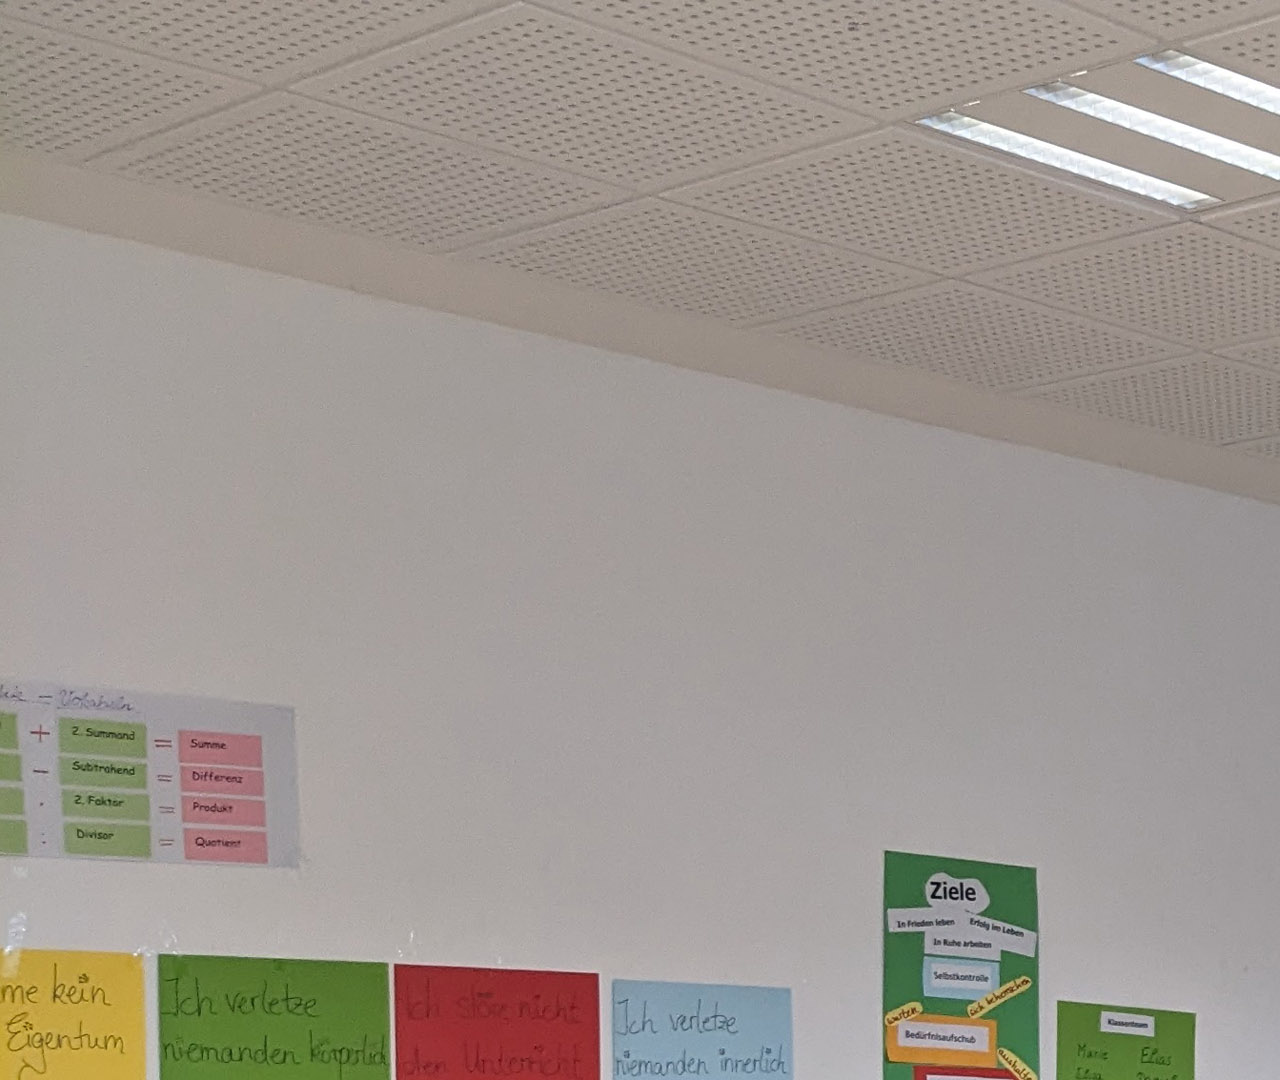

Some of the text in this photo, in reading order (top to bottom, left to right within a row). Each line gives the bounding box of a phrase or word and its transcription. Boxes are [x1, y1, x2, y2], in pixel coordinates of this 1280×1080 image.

[86, 728, 136, 740] Summand
[190, 739, 227, 751] Summe
[72, 761, 136, 775] Subtrahend
[192, 772, 243, 784] Differenz
[88, 797, 125, 808] Faktor
[193, 802, 234, 814] Produkt
[77, 829, 114, 841] Divisor
[195, 837, 242, 849] Quotient
[930, 881, 977, 902] Ziele
[907, 919, 934, 928] Frieden
[969, 917, 990, 931] Erfolg
[1002, 926, 1025, 938] Leben
[943, 938, 962, 948] Ruhe
[53, 962, 112, 1006] kein
[933, 971, 990, 983] Selbstkontrolle
[160, 977, 319, 1018] Ich verletze
[405, 977, 441, 1021] Ich
[519, 992, 584, 1024] nicht
[615, 998, 739, 1036] Ich verletze
[7, 1012, 125, 1074] Eigentum
[904, 1029, 977, 1044] Bedürfnisaufschub
[162, 1031, 300, 1066] niemanden
[464, 1040, 584, 1080] Unterricht
[1140, 1047, 1172, 1066] Elias
[615, 1047, 788, 1077] niemanden innerlich
